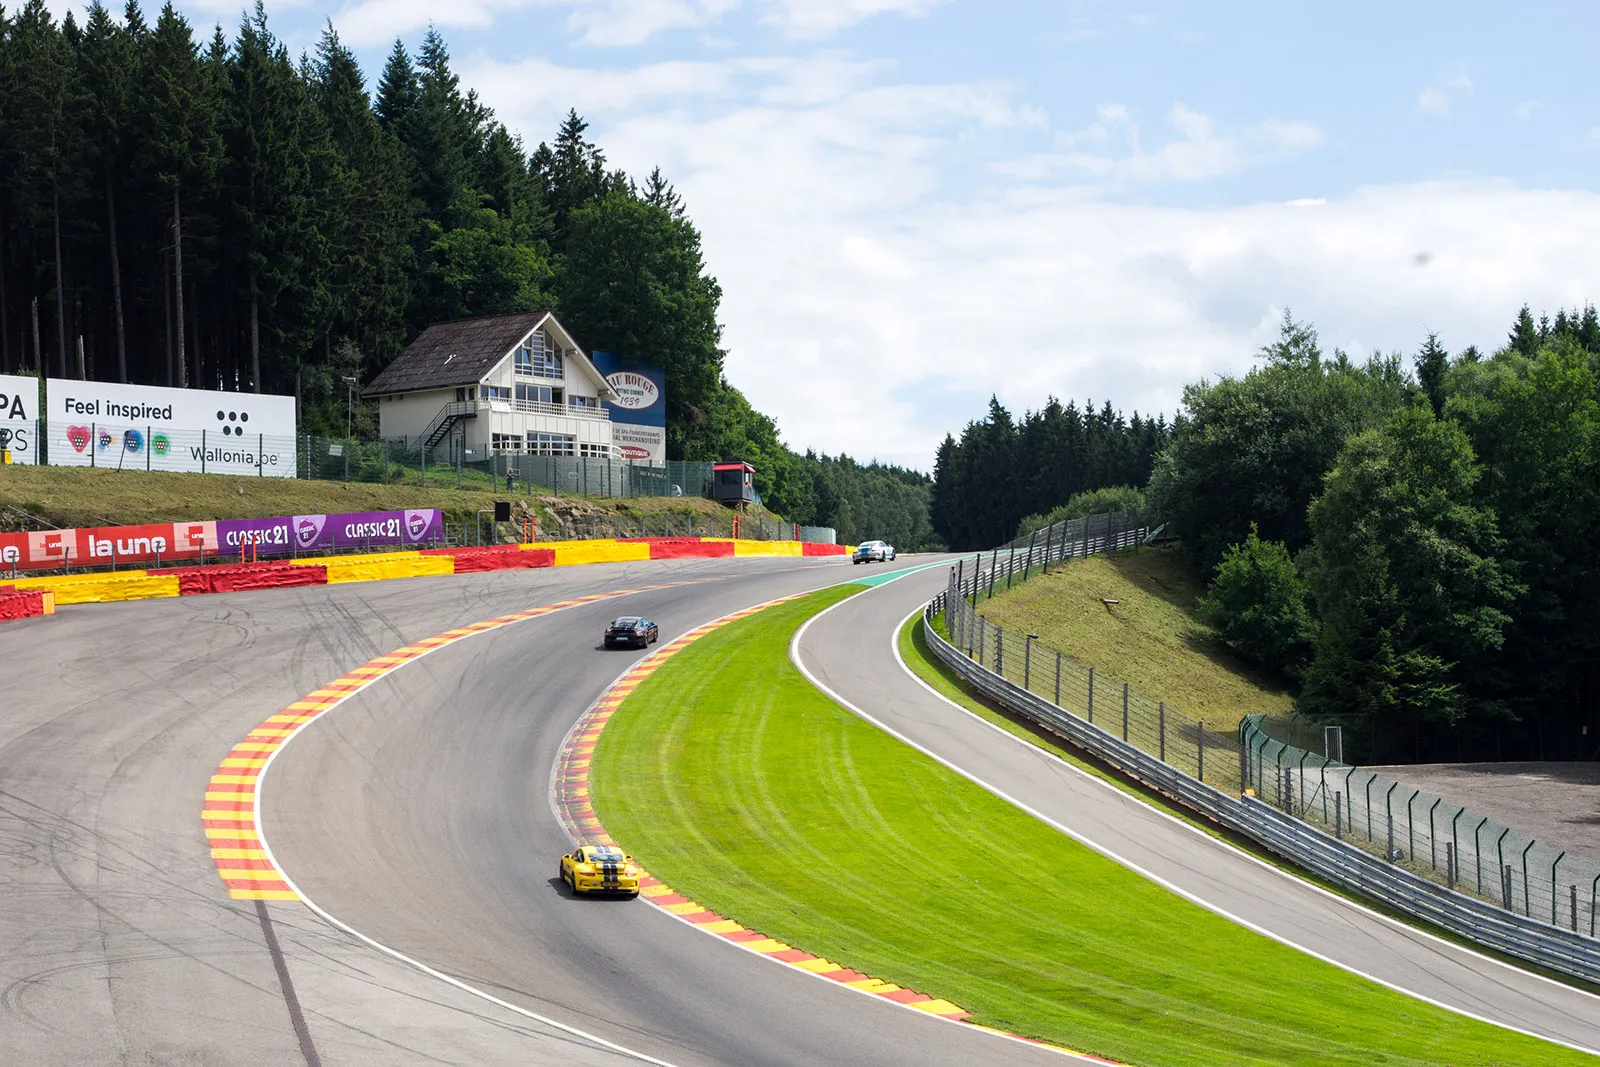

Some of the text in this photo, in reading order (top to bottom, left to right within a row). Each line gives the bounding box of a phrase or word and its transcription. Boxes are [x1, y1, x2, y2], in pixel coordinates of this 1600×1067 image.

[625, 374, 655, 395] ROUGE
[65, 397, 172, 421] Feel inspired
[620, 396, 640, 407] 1939
[622, 435, 660, 445] MERCHANDISING
[226, 525, 289, 546] CLASSIC 21
[299, 525, 315, 534] CLASSIC
[345, 518, 400, 538] CLASSIC 21
[88, 535, 166, 557] la une
